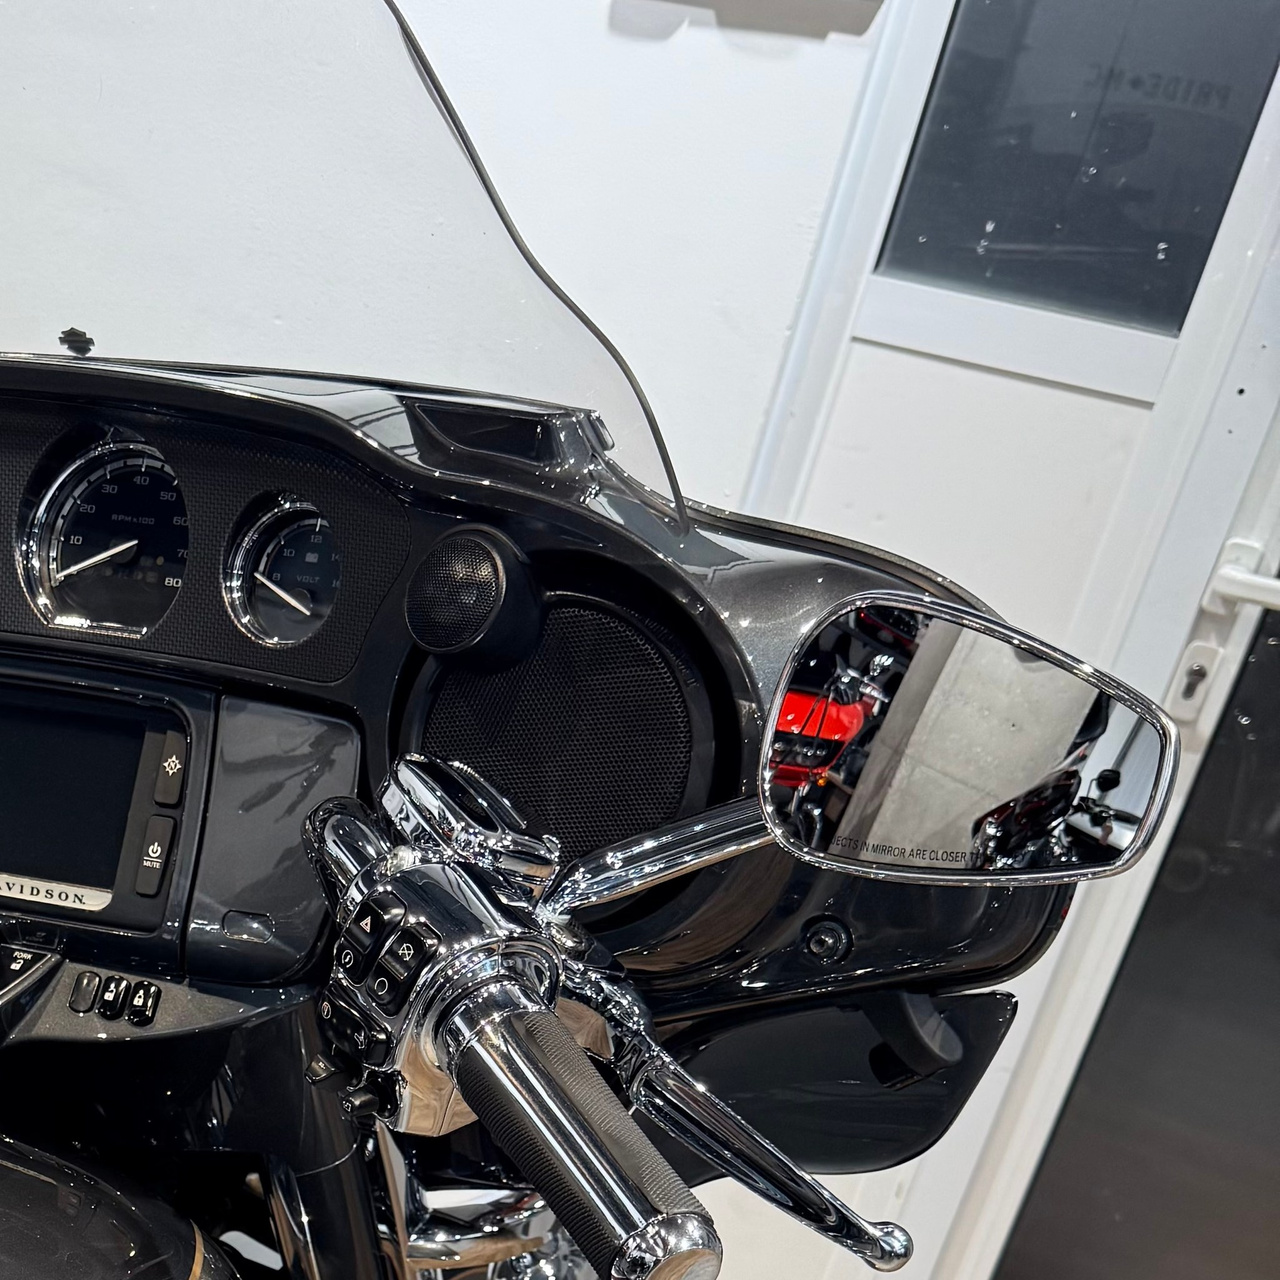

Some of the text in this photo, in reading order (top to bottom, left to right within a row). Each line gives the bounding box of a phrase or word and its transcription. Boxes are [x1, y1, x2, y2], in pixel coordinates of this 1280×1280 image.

[133, 475, 149, 485] 40
[101, 484, 118, 494] 30
[160, 491, 176, 501] 50
[80, 503, 96, 513] 20
[111, 513, 131, 523] RPM
[173, 517, 189, 526] 60
[69, 535, 83, 545] 10
[310, 535, 323, 543] 12
[282, 548, 295, 557] 10
[272, 572, 281, 581] 8
[296, 574, 320, 583] VOLT
[164, 577, 181, 587] 80
[831, 834, 859, 850] JECTS
[860, 841, 870, 853] IN
[871, 843, 906, 859] MIRROR
[908, 848, 928, 860] ARE
[929, 851, 967, 863] CLOSER
[143, 860, 161, 869] MUTE
[12, 951, 33, 960] FORK
